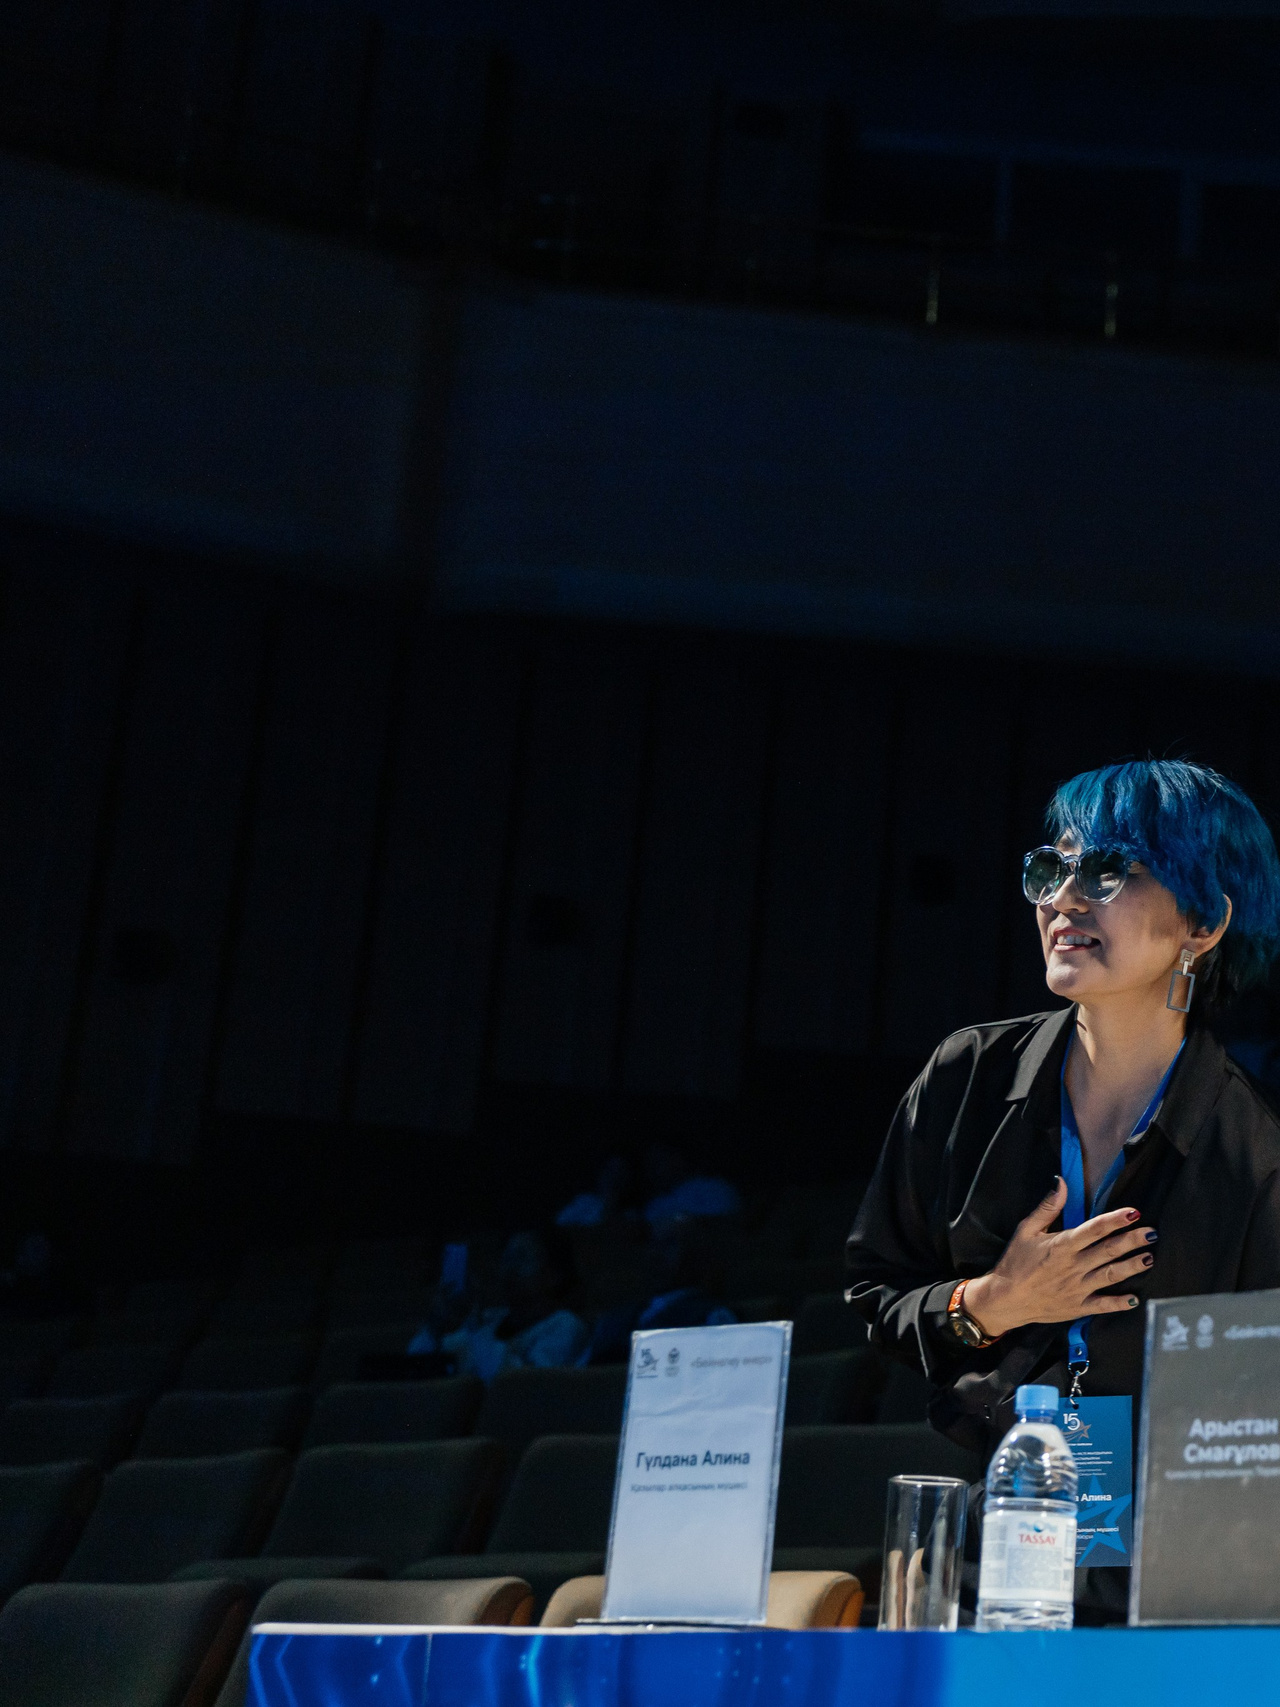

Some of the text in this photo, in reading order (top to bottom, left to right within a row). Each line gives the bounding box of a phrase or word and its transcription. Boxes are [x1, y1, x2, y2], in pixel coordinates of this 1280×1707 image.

[1063, 1413, 1081, 1431] 15
[1188, 1418, 1279, 1442] Арыстан
[702, 1450, 750, 1466] Алина
[1081, 1493, 1112, 1501] Алина
[1019, 1534, 1056, 1545] TASSAY
